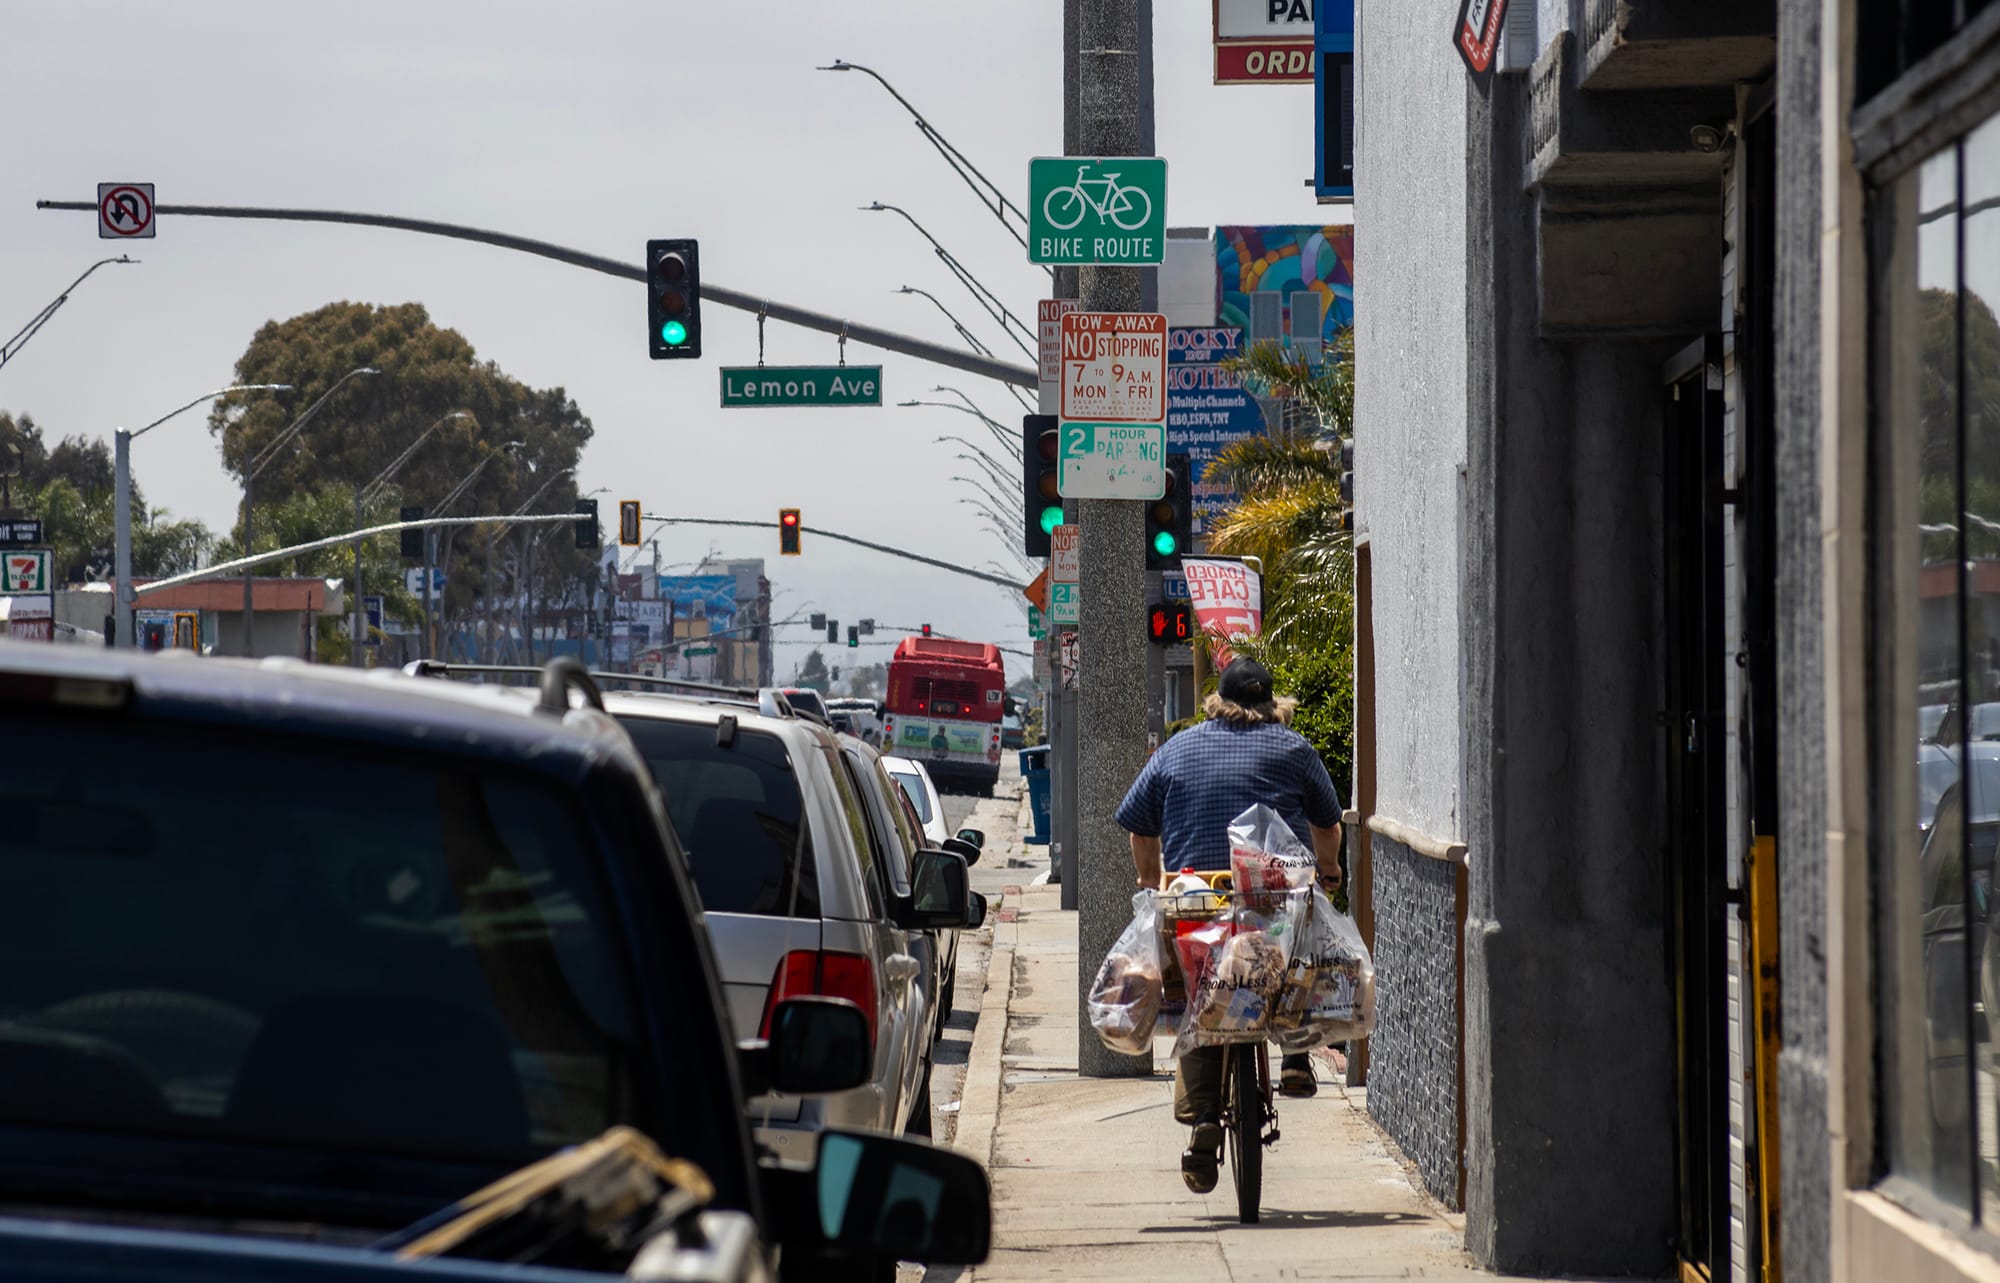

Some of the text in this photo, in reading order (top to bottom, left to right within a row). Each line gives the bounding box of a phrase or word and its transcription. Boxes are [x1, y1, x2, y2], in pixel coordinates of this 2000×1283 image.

[1268, 0, 1315, 23] PA
[1041, 238, 1153, 258] BIKE ROUTE
[1040, 302, 1060, 320] NO
[1064, 331, 1160, 358] NO STOPPING
[1073, 363, 1086, 382] 7
[1095, 368, 1104, 377] TO
[727, 376, 875, 397] Lemon Ave
[1073, 385, 1106, 399] MON
[1128, 385, 1153, 399] FRI
[1068, 427, 1146, 456] 2 HOUR
[1054, 535, 1070, 550] NO
[1058, 563, 1077, 571] MON
[1056, 586, 1066, 601] 2
[1168, 580, 1188, 597] LE
[1176, 613, 1186, 637] 6
